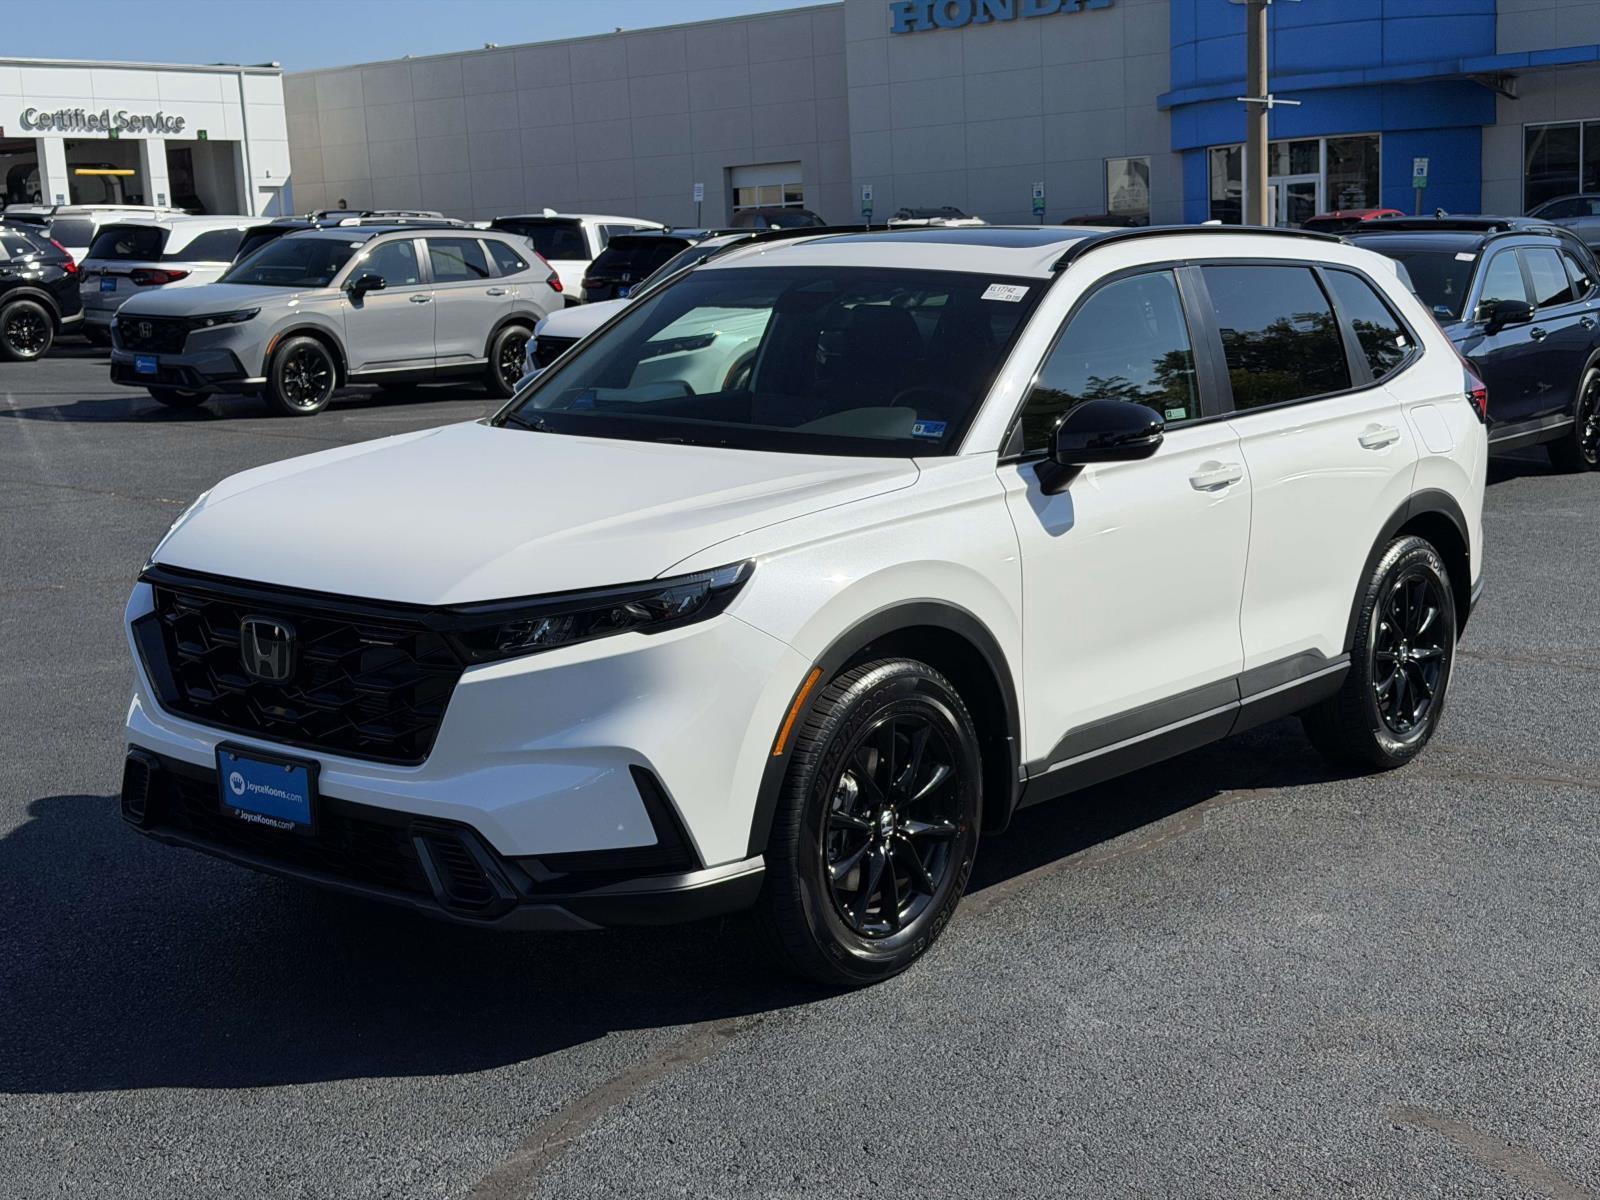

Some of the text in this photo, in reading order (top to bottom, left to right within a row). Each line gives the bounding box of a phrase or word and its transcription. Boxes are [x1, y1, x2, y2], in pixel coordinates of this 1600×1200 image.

[20, 107, 187, 133] Certified Service
[246, 780, 303, 803] JoyceKoons.com
[240, 809, 293, 831] JoyceKoons.com
